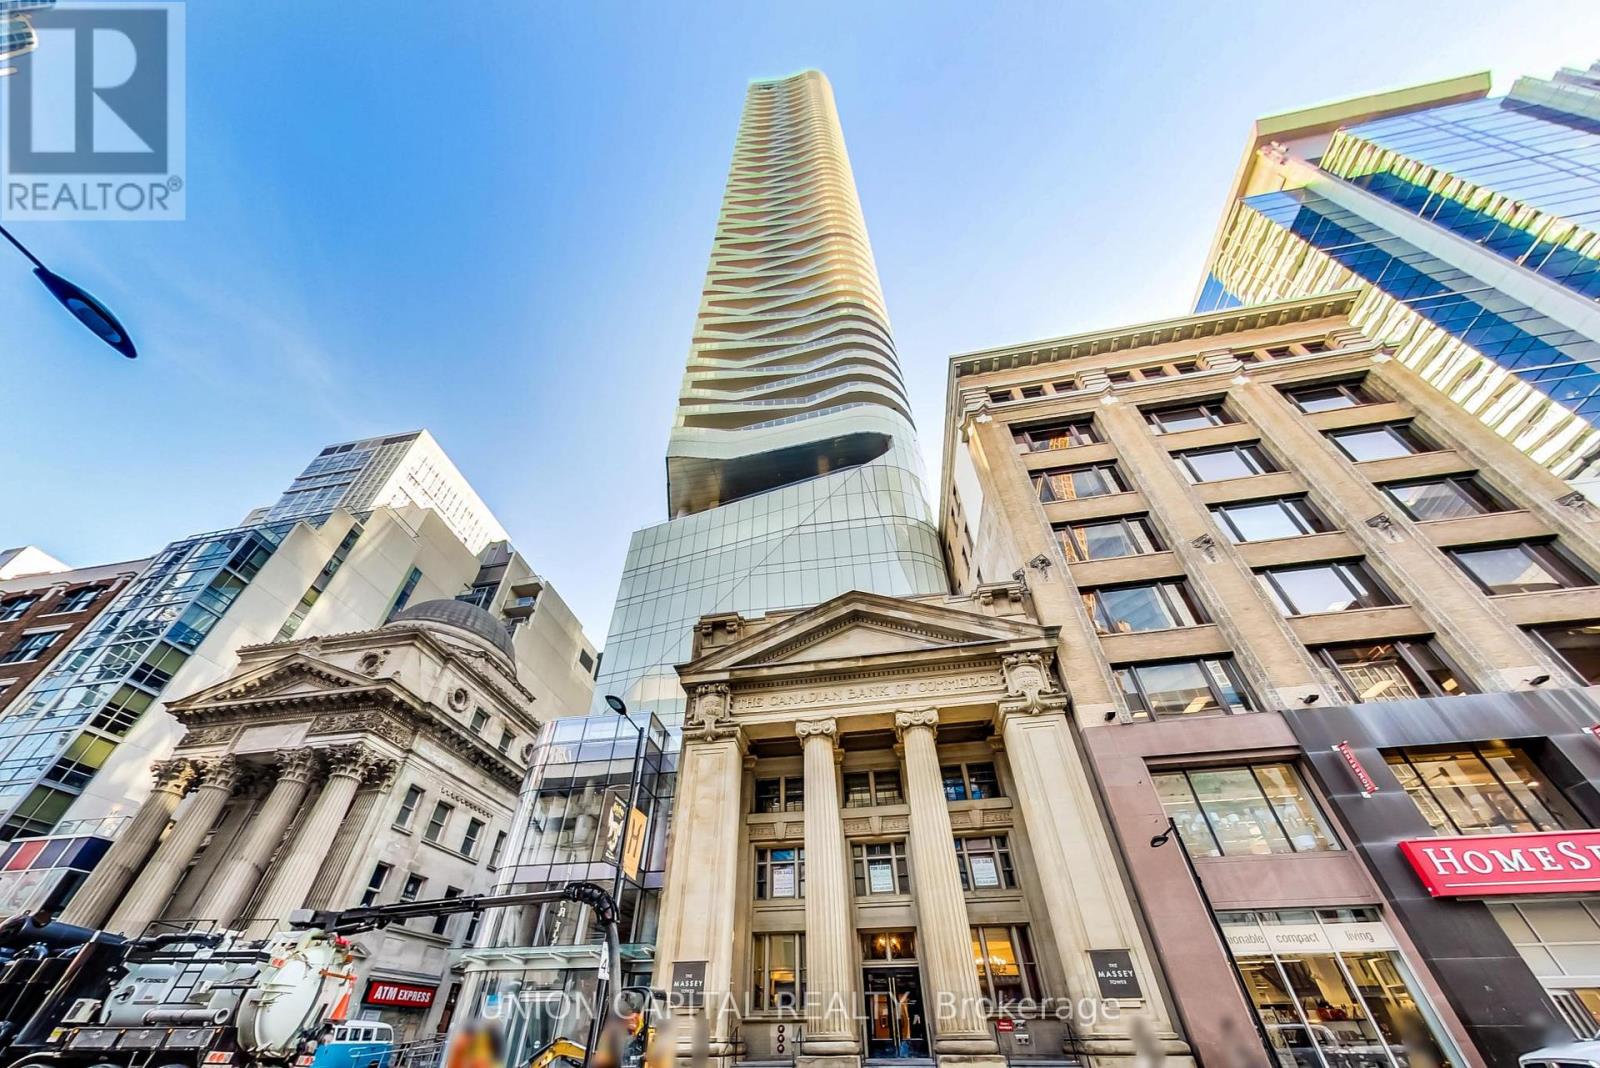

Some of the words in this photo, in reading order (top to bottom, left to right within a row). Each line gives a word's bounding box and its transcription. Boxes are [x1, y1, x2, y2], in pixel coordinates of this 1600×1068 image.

[769, 691, 842, 706] CANADIAN
[847, 684, 890, 700] BANK
[895, 683, 911, 695] OF
[918, 674, 999, 694] COMMERCE
[1275, 932, 1320, 944] compact
[1344, 929, 1375, 943] living
[1097, 970, 1133, 978] MASSEY
[373, 985, 398, 1001] ATM
[397, 989, 432, 1003] EXPRESS
